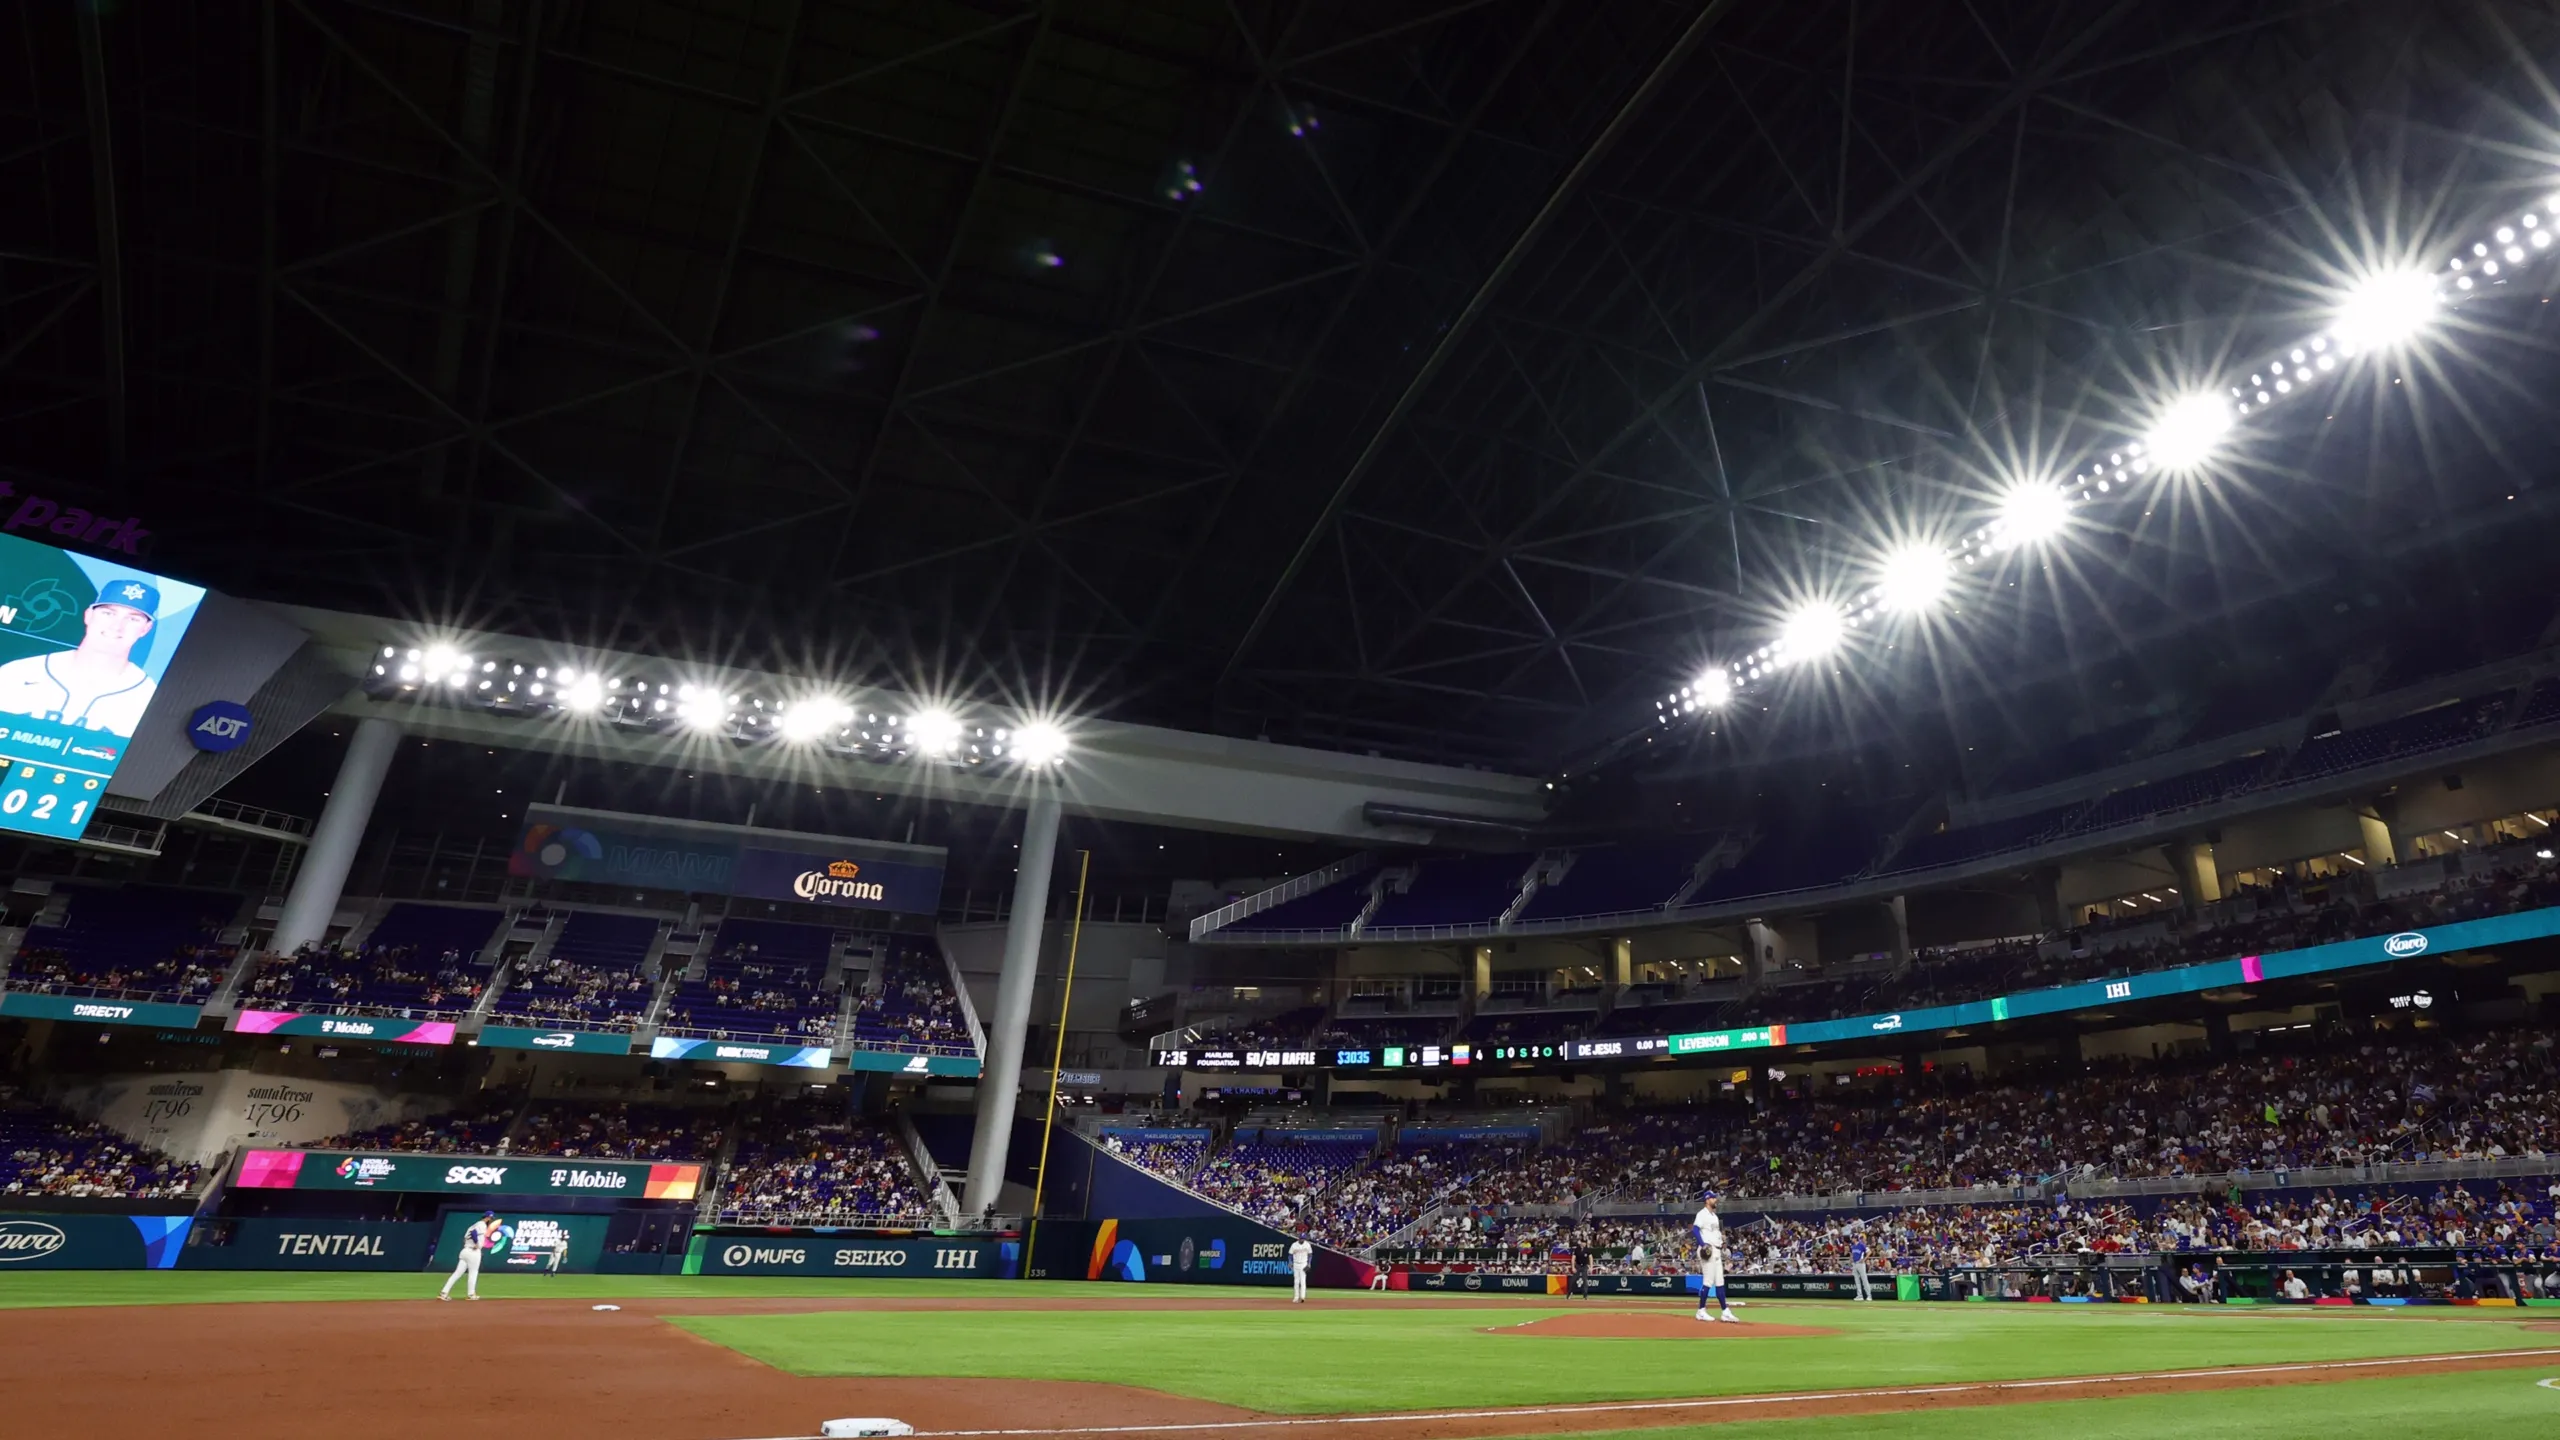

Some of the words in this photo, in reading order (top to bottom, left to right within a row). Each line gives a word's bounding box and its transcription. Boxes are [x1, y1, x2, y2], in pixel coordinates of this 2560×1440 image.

[3, 496, 149, 555] park
[196, 716, 248, 739] ADT
[11, 731, 62, 750] MIAMI
[20, 766, 36, 778] B
[53, 772, 66, 785] S
[84, 779, 98, 790] O
[2, 789, 28, 814] 0
[31, 794, 58, 819] 2
[70, 800, 88, 825] 1
[793, 870, 884, 901] Corona
[2105, 981, 2131, 999] IHI
[73, 1004, 134, 1018] DIRECTV
[333, 1022, 375, 1034] Mobile
[1578, 1044, 1591, 1056] DE
[1593, 1042, 1622, 1055] JESUS
[1637, 1040, 1653, 1050] 0.00
[1656, 1040, 1668, 1048] ERA
[1679, 1035, 1729, 1050] LEVENSON
[1246, 1051, 1280, 1067] 50/50
[1282, 1052, 1316, 1065] RAFFLE
[1337, 1051, 1370, 1065] $3035
[1410, 1051, 1418, 1063] 0
[1476, 1050, 1483, 1061] 4
[1496, 1048, 1504, 1058] B
[1507, 1047, 1515, 1058] 0
[1520, 1048, 1527, 1058] S
[1532, 1047, 1539, 1057] 2
[1197, 1059, 1240, 1067] FOUNDATION
[1235, 1087, 1265, 1095] CHANGE
[445, 1165, 508, 1185] SCSK
[567, 1169, 627, 1189] Mobile
[518, 1220, 559, 1230] WORLD
[278, 1234, 386, 1256] TENTIAL
[1253, 1244, 1285, 1258] EXPECT
[753, 1249, 806, 1265] MUFG
[834, 1249, 906, 1266] SEIKO
[934, 1249, 979, 1269] IHI
[1502, 1278, 1529, 1287] KONAMI
